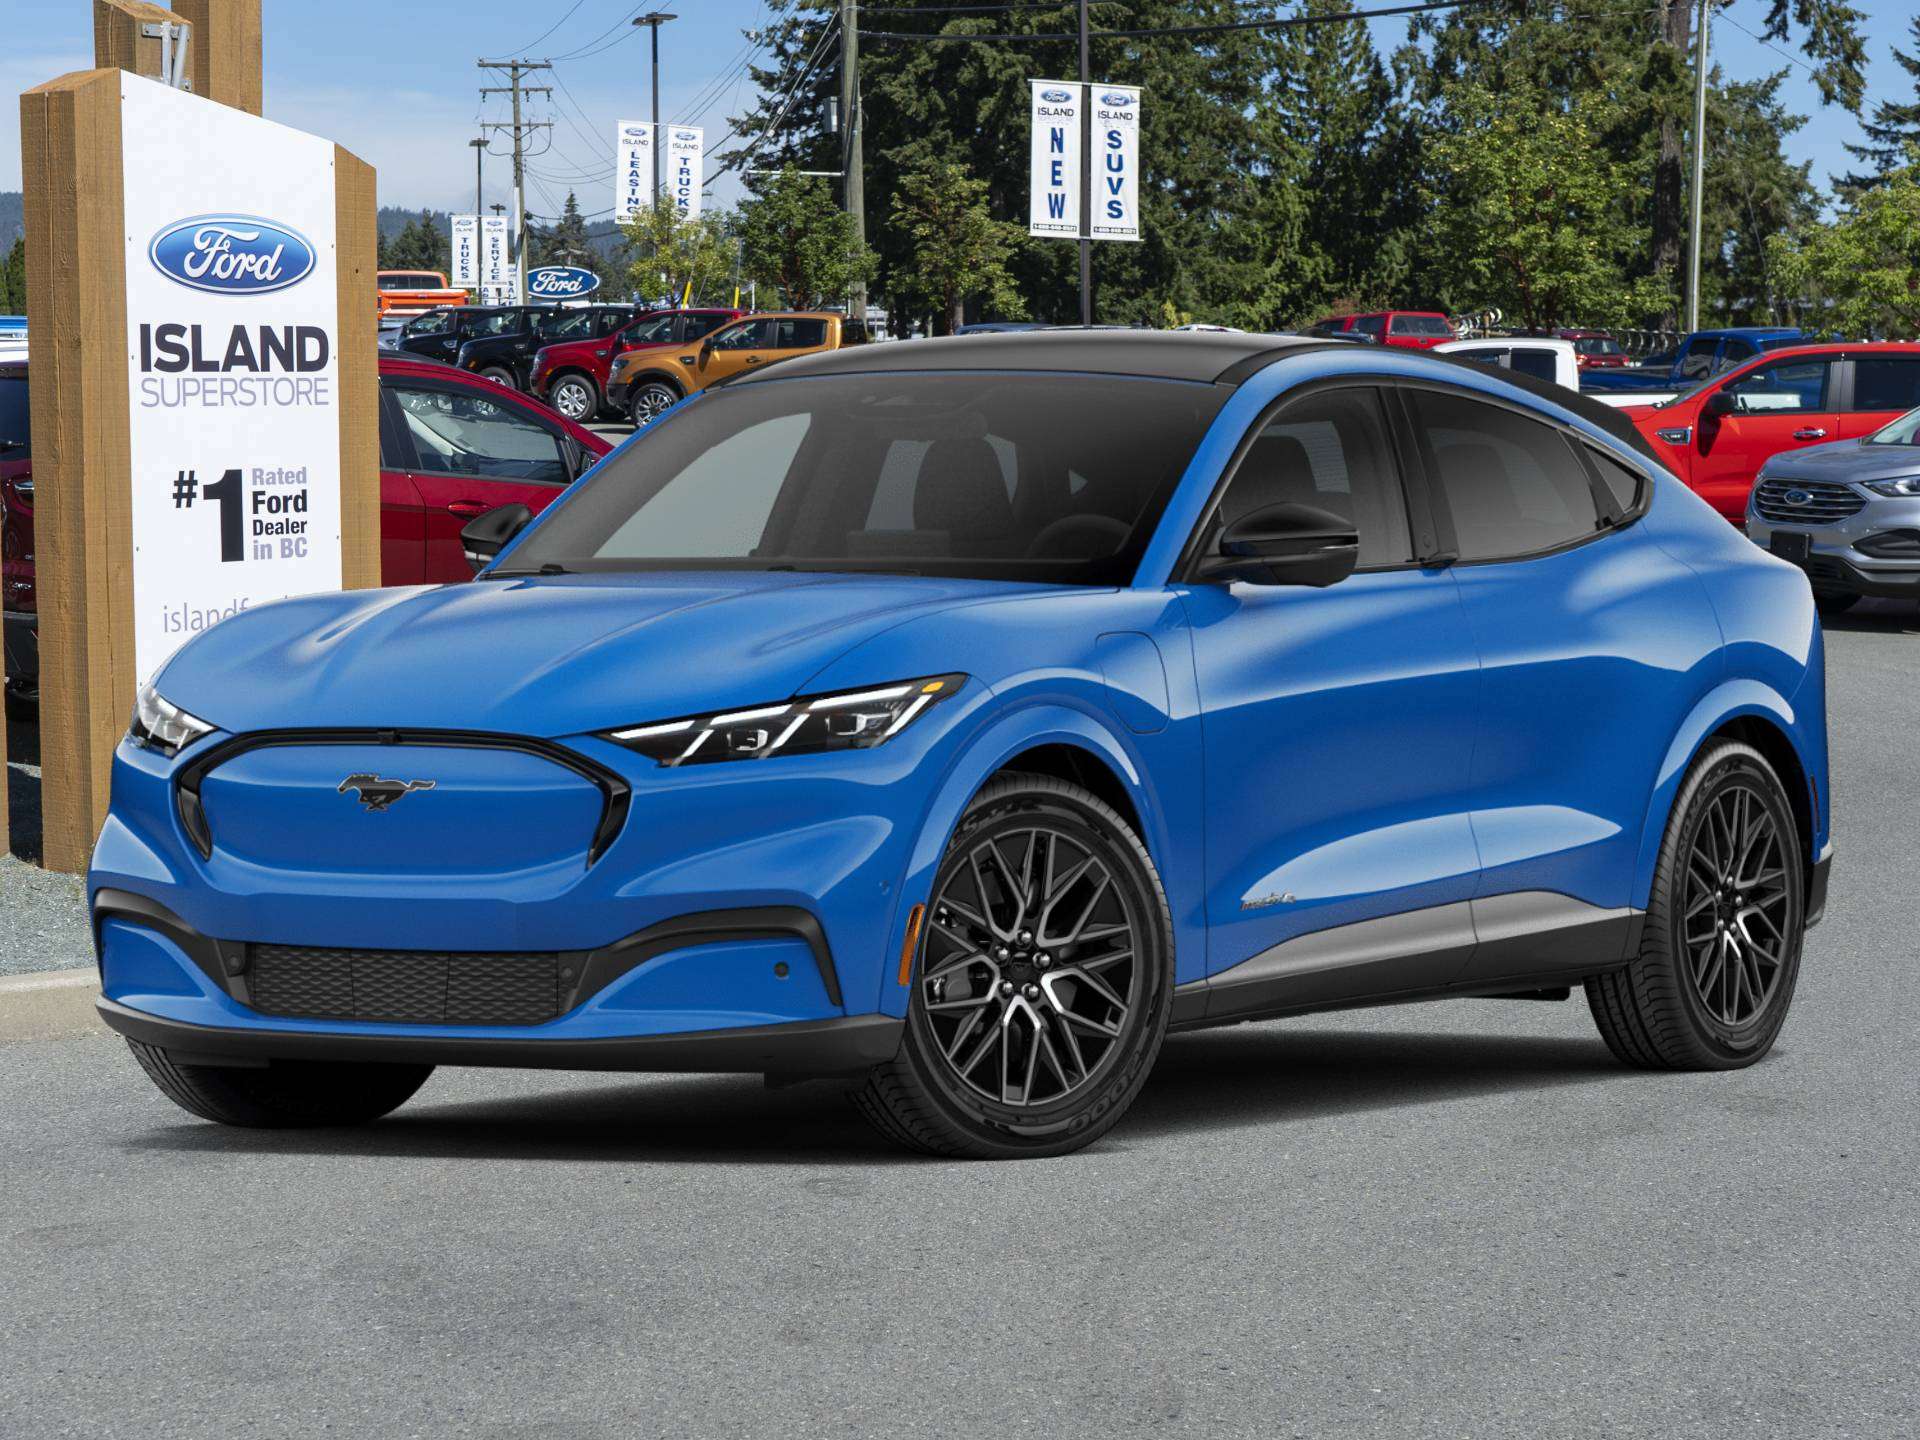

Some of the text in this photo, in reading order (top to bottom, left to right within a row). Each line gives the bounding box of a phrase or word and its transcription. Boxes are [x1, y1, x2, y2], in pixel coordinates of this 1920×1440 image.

[1038, 107, 1074, 117] ISLAND
[1098, 110, 1133, 121] ISLAND
[1048, 127, 1066, 219] NEW
[1106, 129, 1124, 219] SUVS
[183, 226, 284, 281] Ford
[460, 237, 469, 279] TRUCKS
[491, 237, 500, 281] SERVICE
[532, 271, 582, 292] Ford
[139, 323, 329, 373] ISLAND
[140, 377, 329, 408] SUPERSTORE
[252, 466, 307, 486] Rated
[252, 489, 308, 514] Ford
[252, 518, 308, 536] Dealer
[253, 537, 308, 560] in BC
